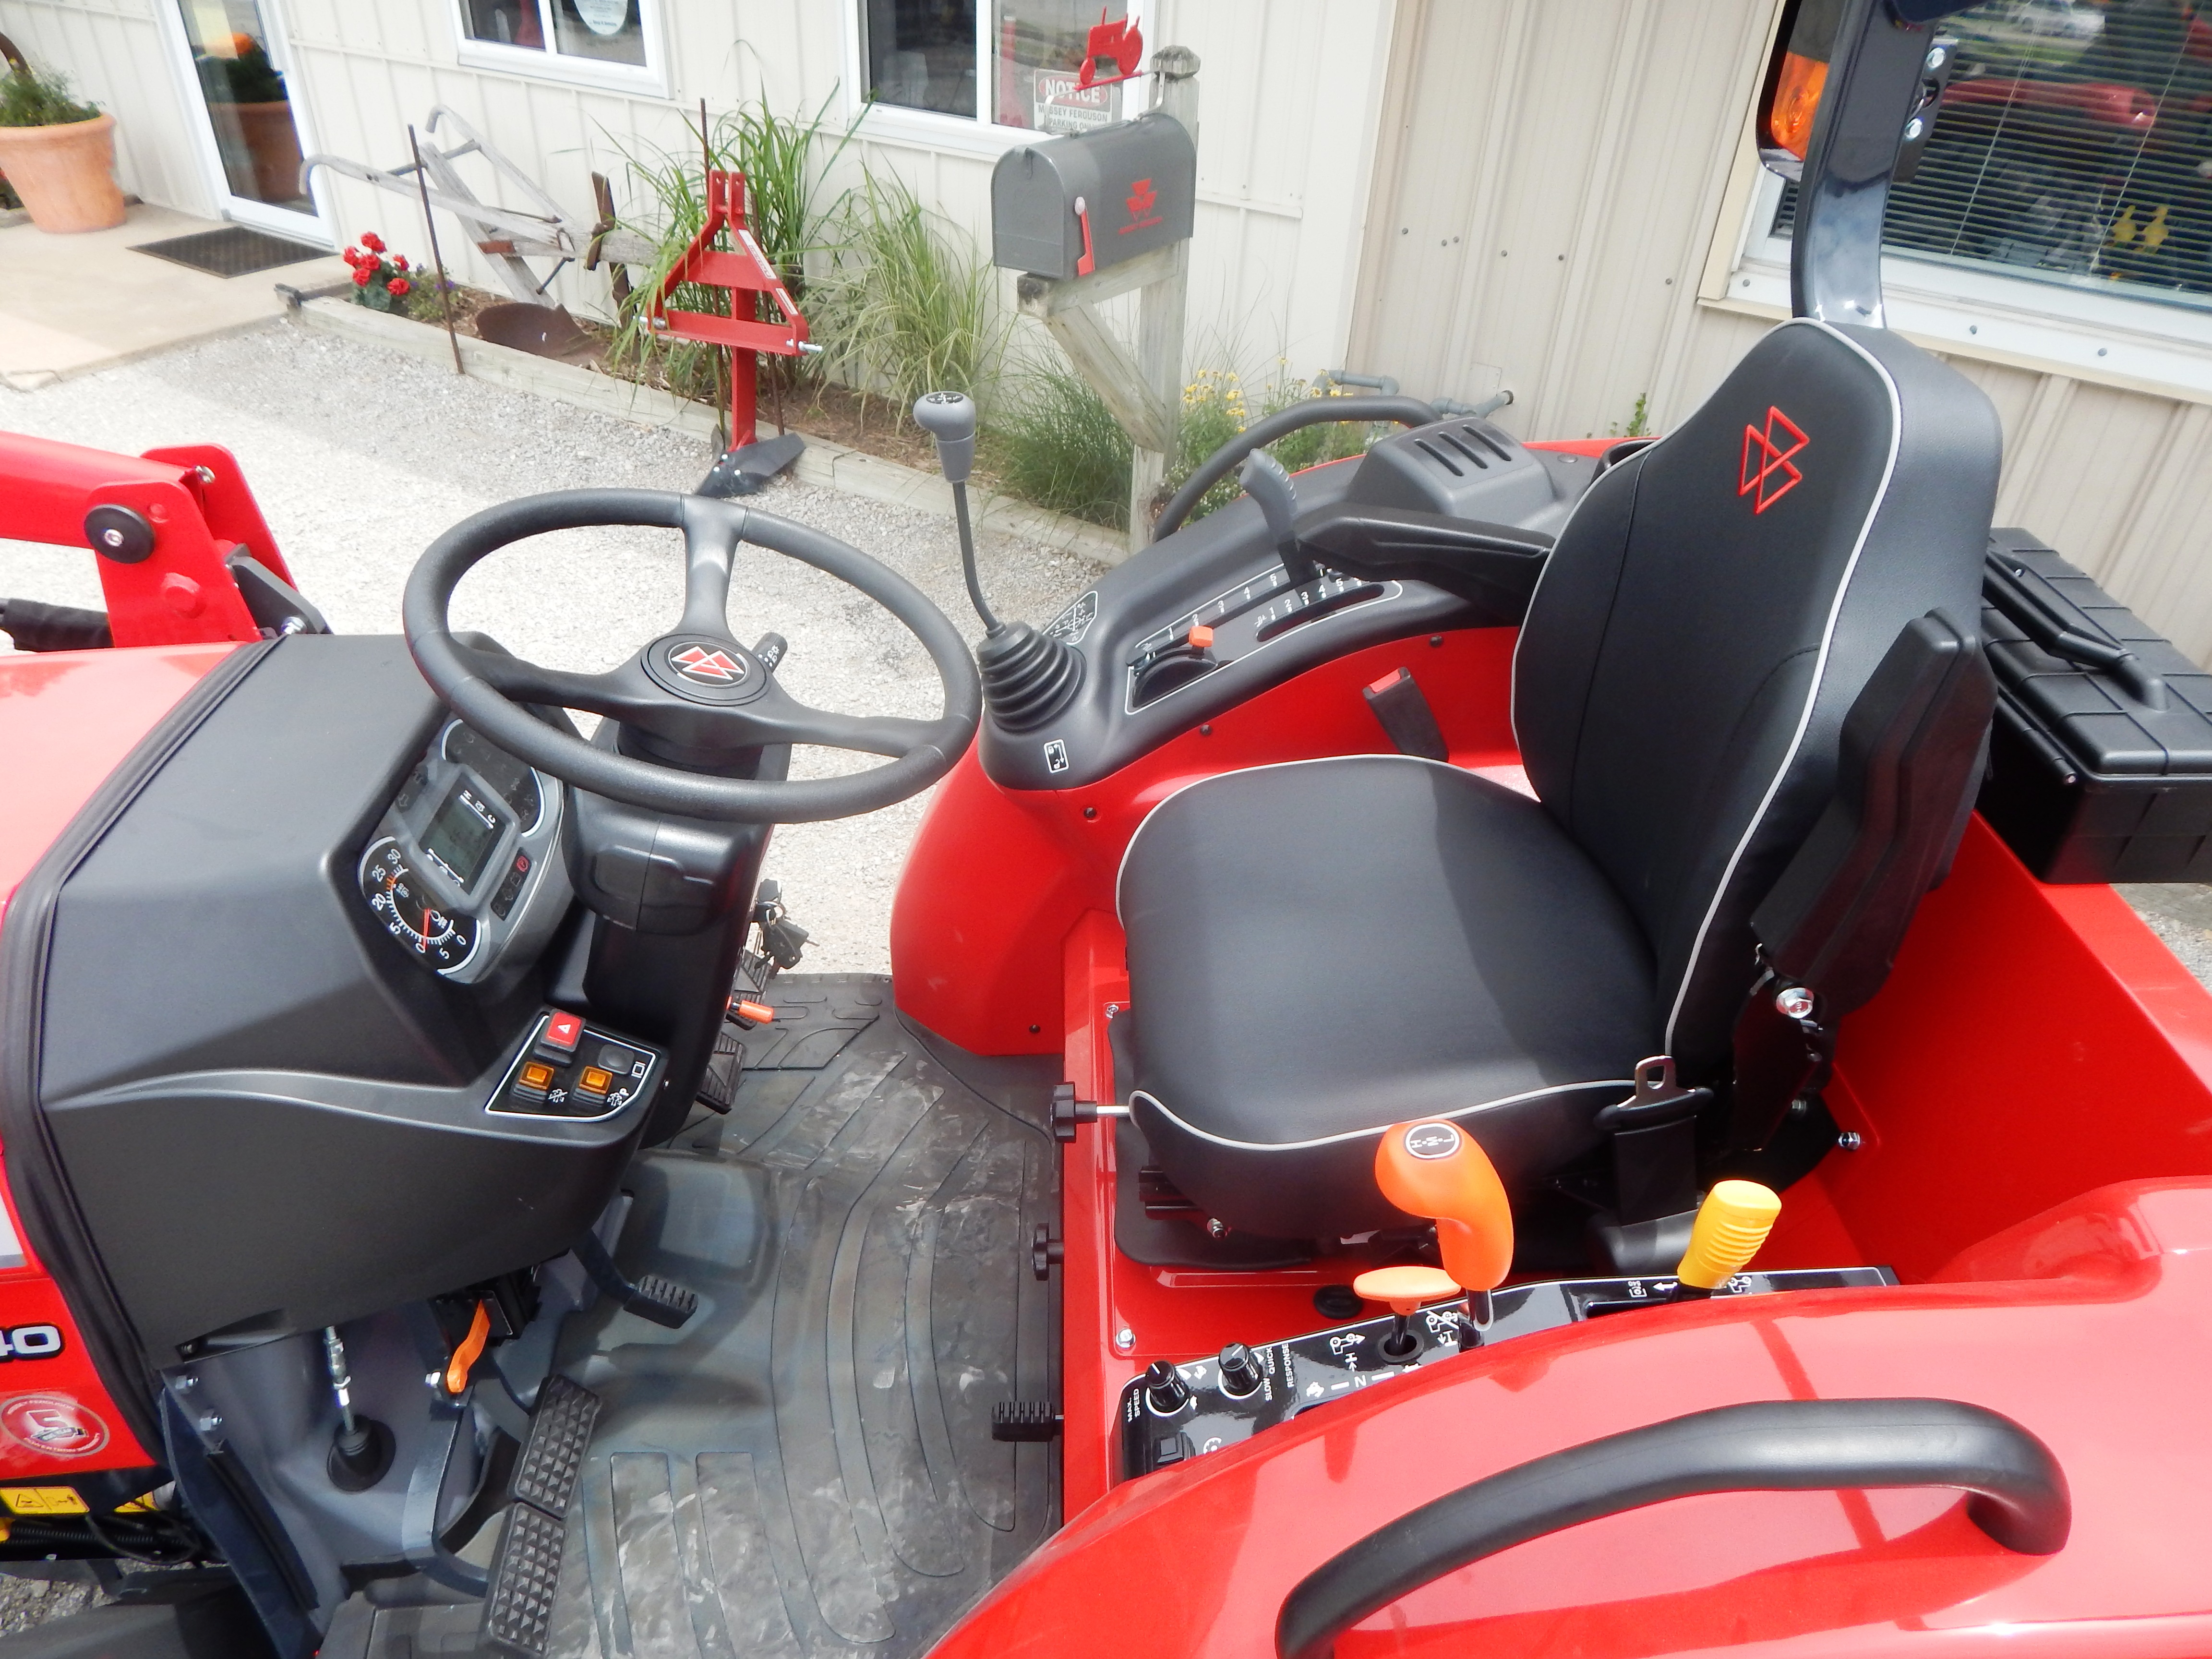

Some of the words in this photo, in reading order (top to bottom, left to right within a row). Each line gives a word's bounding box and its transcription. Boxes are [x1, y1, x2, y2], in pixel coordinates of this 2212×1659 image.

[1046, 79, 1100, 103] NOTICE
[1038, 105, 1067, 116] MSSEY
[1069, 109, 1107, 122] FERGUSON
[1192, 613, 1199, 622] 2
[1218, 600, 1224, 608] 3
[1244, 586, 1250, 595] 4
[1270, 573, 1276, 581] 5
[1284, 599, 1291, 607] 2
[1301, 591, 1309, 601] 3
[1319, 584, 1326, 593] 4
[1336, 577, 1343, 587] 5
[387, 848, 401, 865] 30
[372, 865, 386, 882] 25
[371, 892, 386, 911] 20
[439, 948, 450, 960] 5
[0, 1325, 61, 1357] 0
[1265, 1346, 1276, 1375] QUICK
[1282, 1343, 1295, 1388] RESPONSE
[1354, 1375, 1367, 1388] N
